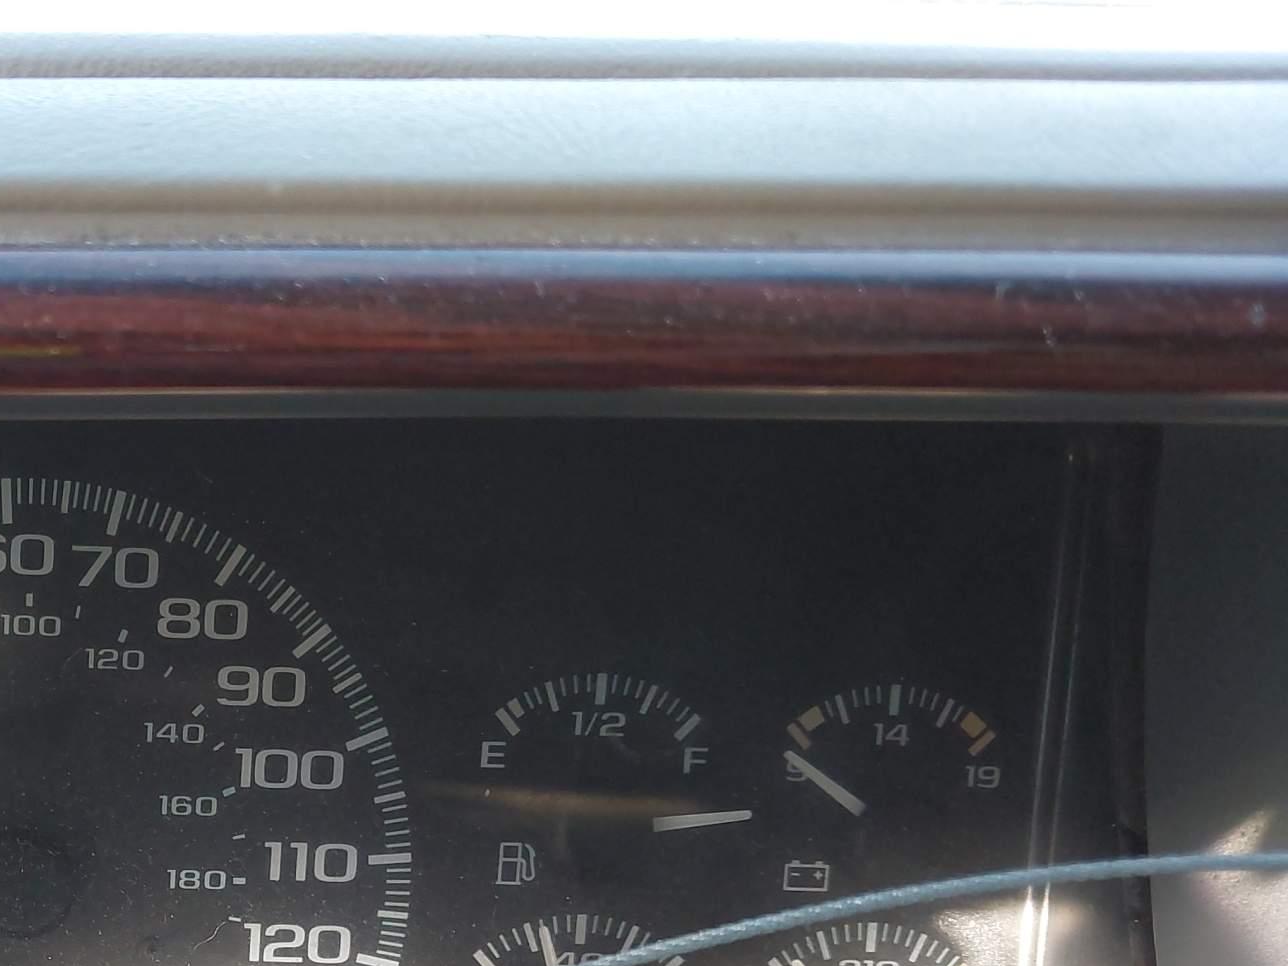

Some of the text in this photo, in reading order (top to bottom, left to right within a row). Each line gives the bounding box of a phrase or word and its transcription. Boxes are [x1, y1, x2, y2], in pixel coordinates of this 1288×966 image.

[72, 545, 159, 589] 70
[0, 614, 61, 637] 100
[157, 598, 248, 641] 80
[85, 648, 145, 671] 120
[216, 665, 306, 707] 90
[143, 722, 204, 744] 140
[572, 711, 625, 737] 1/2
[874, 723, 909, 746] 14
[481, 741, 505, 767] E
[683, 747, 708, 774] F
[235, 748, 344, 790] 100
[966, 765, 1000, 788] 19
[159, 795, 217, 816] 160
[264, 841, 358, 883] 110
[167, 869, 227, 890] 180
[243, 923, 351, 964] 120
